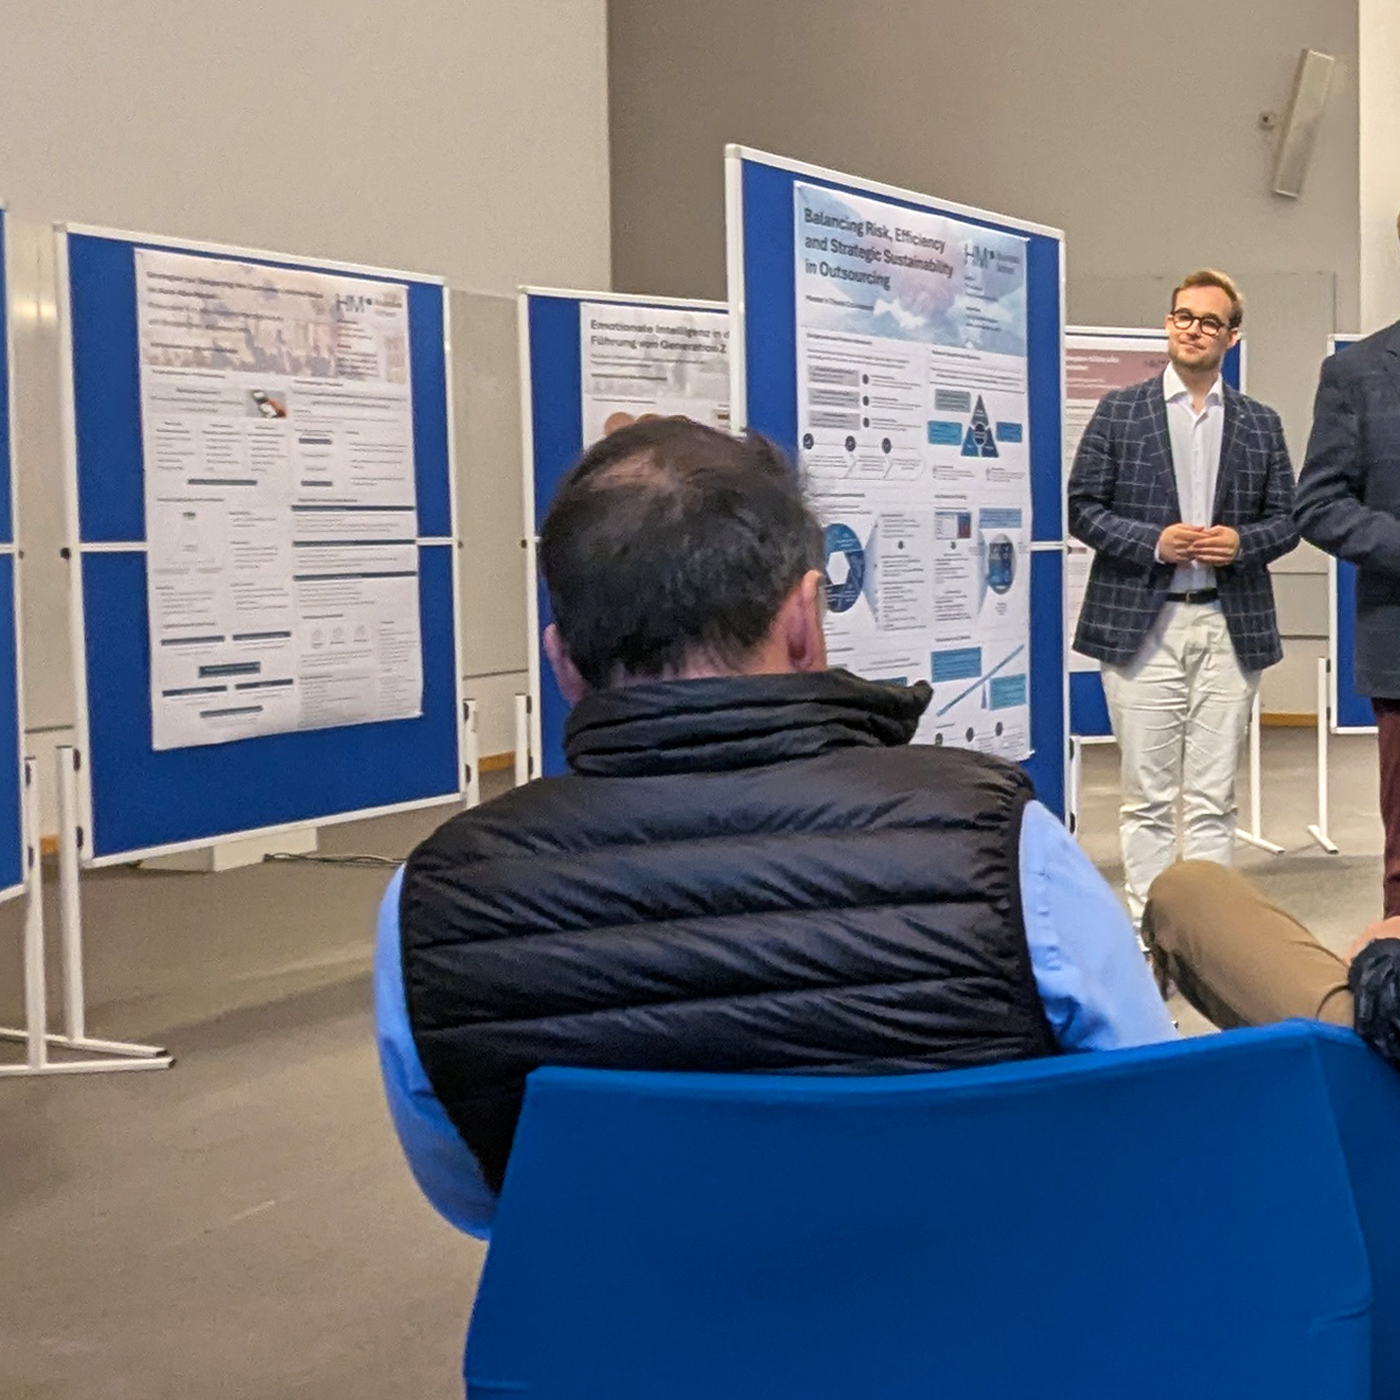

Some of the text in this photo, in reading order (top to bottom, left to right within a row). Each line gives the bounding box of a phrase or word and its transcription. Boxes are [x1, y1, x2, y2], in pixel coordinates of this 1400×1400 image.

[804, 207, 946, 254] Balancing Risk, Efficiency
[805, 236, 954, 279] and Strategic Sustainability
[805, 258, 891, 291] in Outsourcing
[590, 319, 653, 334] Emotionale
[655, 324, 710, 338] Intelligenz
[590, 336, 636, 349] Führung
[660, 339, 717, 352] Generation
